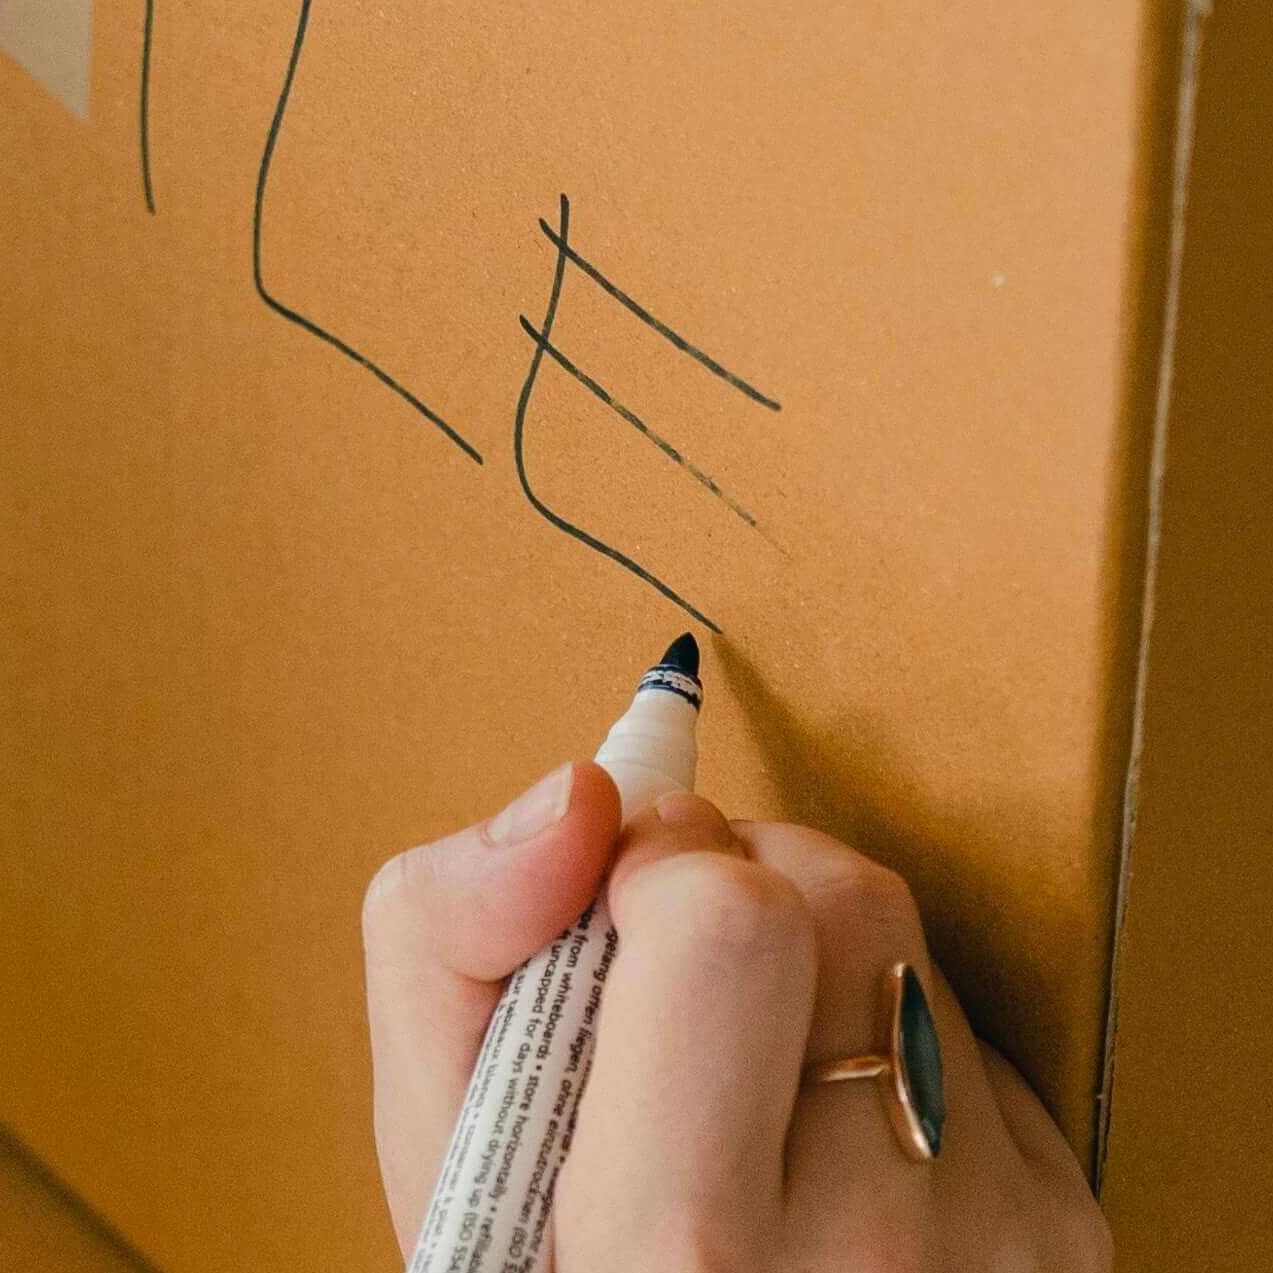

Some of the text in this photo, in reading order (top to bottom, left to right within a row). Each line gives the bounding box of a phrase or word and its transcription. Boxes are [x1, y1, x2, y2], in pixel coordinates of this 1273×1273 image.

[566, 933, 587, 970] from
[594, 927, 620, 981] gelang
[531, 943, 564, 1014] uncapped
[536, 972, 575, 1061] whiteboards
[584, 984, 604, 1025] offen
[525, 1018, 540, 1039] for
[511, 1041, 531, 1075] days
[493, 1077, 521, 1136] without
[520, 1074, 540, 1111] store
[554, 1078, 574, 1116] ohne
[474, 1137, 501, 1186] drying
[489, 1114, 529, 1201] horizontally
[467, 1187, 481, 1207] up
